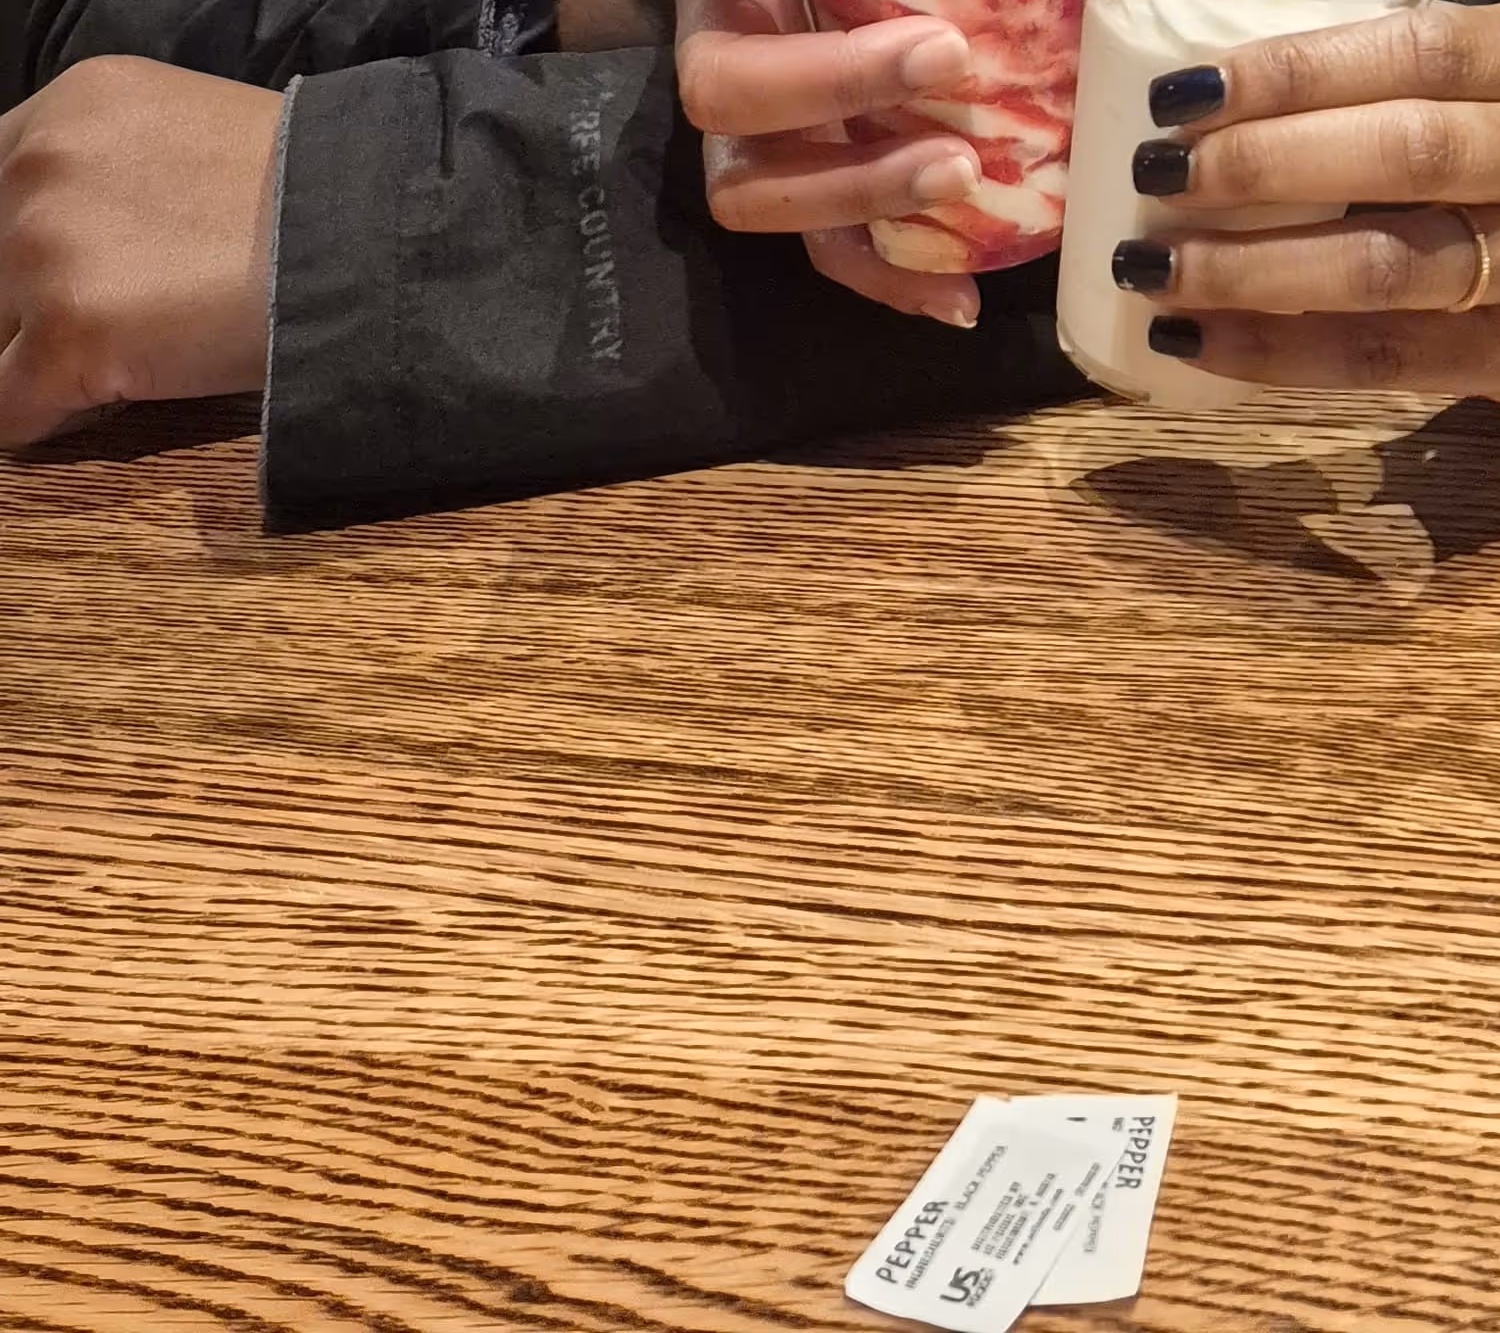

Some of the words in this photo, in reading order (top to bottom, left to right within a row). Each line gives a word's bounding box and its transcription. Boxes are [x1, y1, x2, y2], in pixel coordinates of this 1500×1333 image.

[578, 186, 623, 360] COUNTRY
[1115, 1116, 1156, 1189] PEPPER
[875, 1200, 950, 1284] PEPPER
